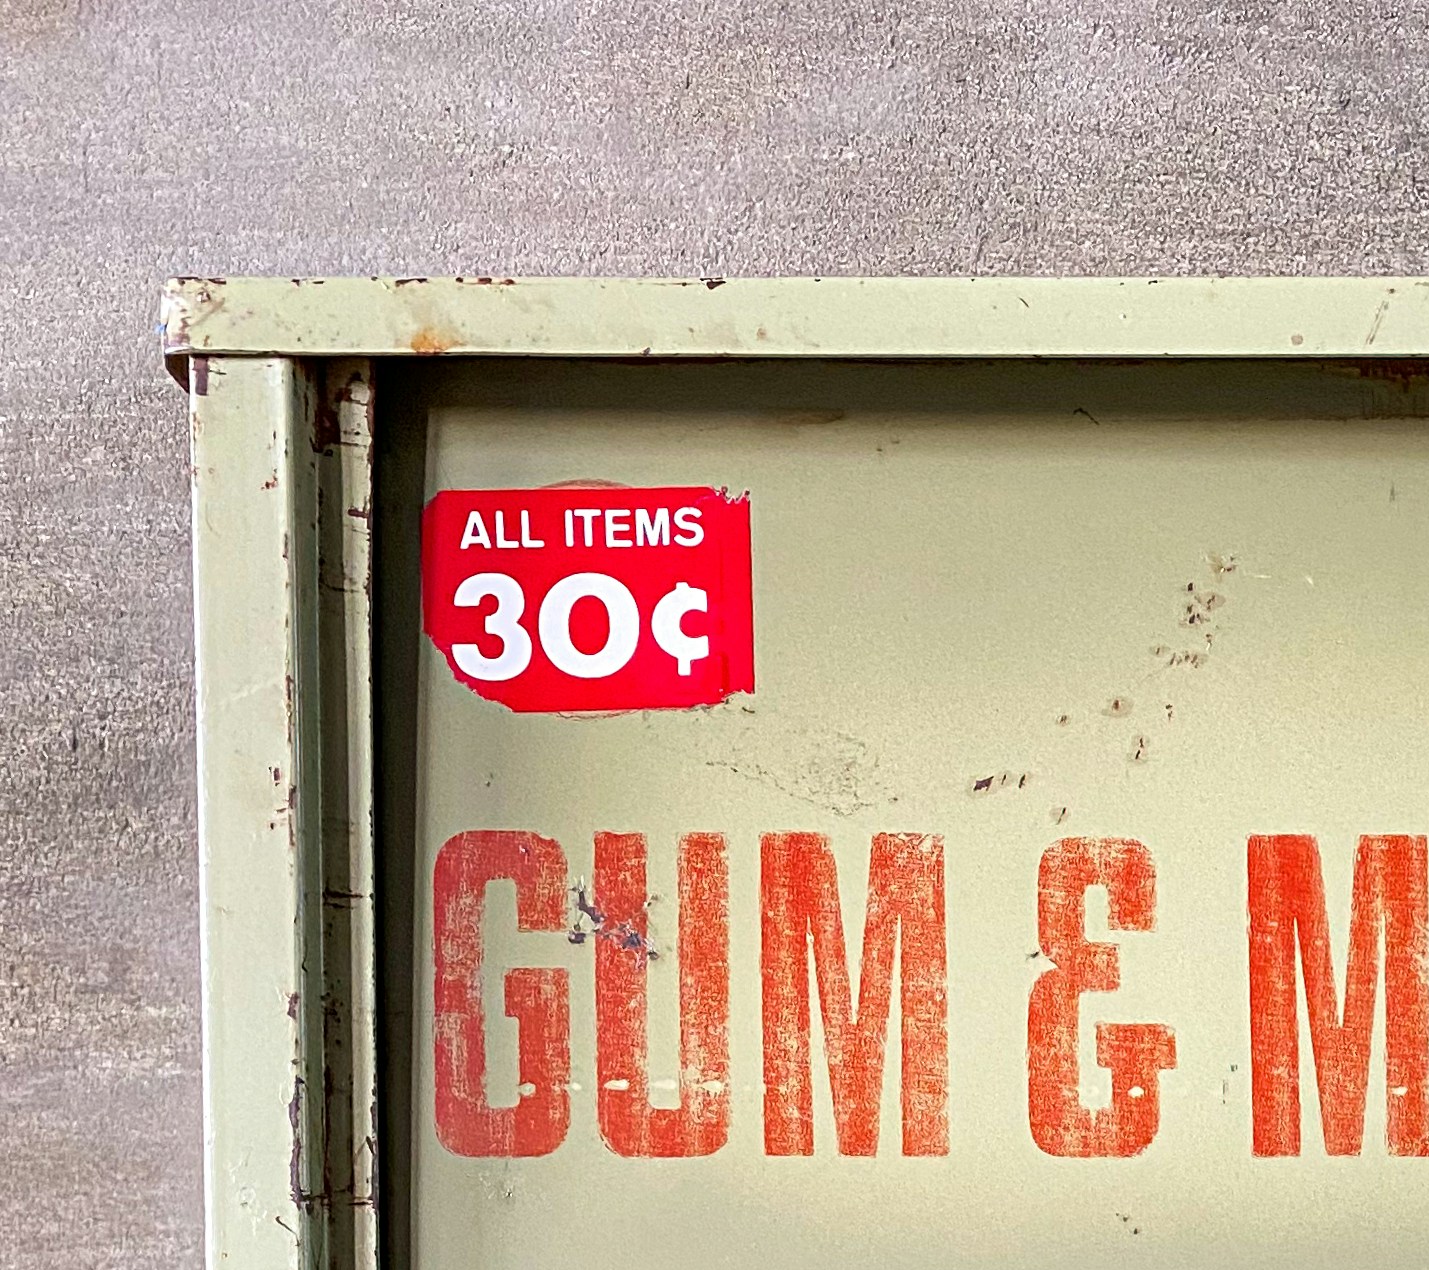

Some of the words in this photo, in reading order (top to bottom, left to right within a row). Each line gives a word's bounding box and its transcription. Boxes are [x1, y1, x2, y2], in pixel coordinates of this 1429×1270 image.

[460, 510, 545, 549] ALL
[565, 507, 705, 547] ITEMS
[451, 572, 710, 681] 30¢
[433, 831, 950, 1158] GUM
[1027, 836, 1178, 1159] &
